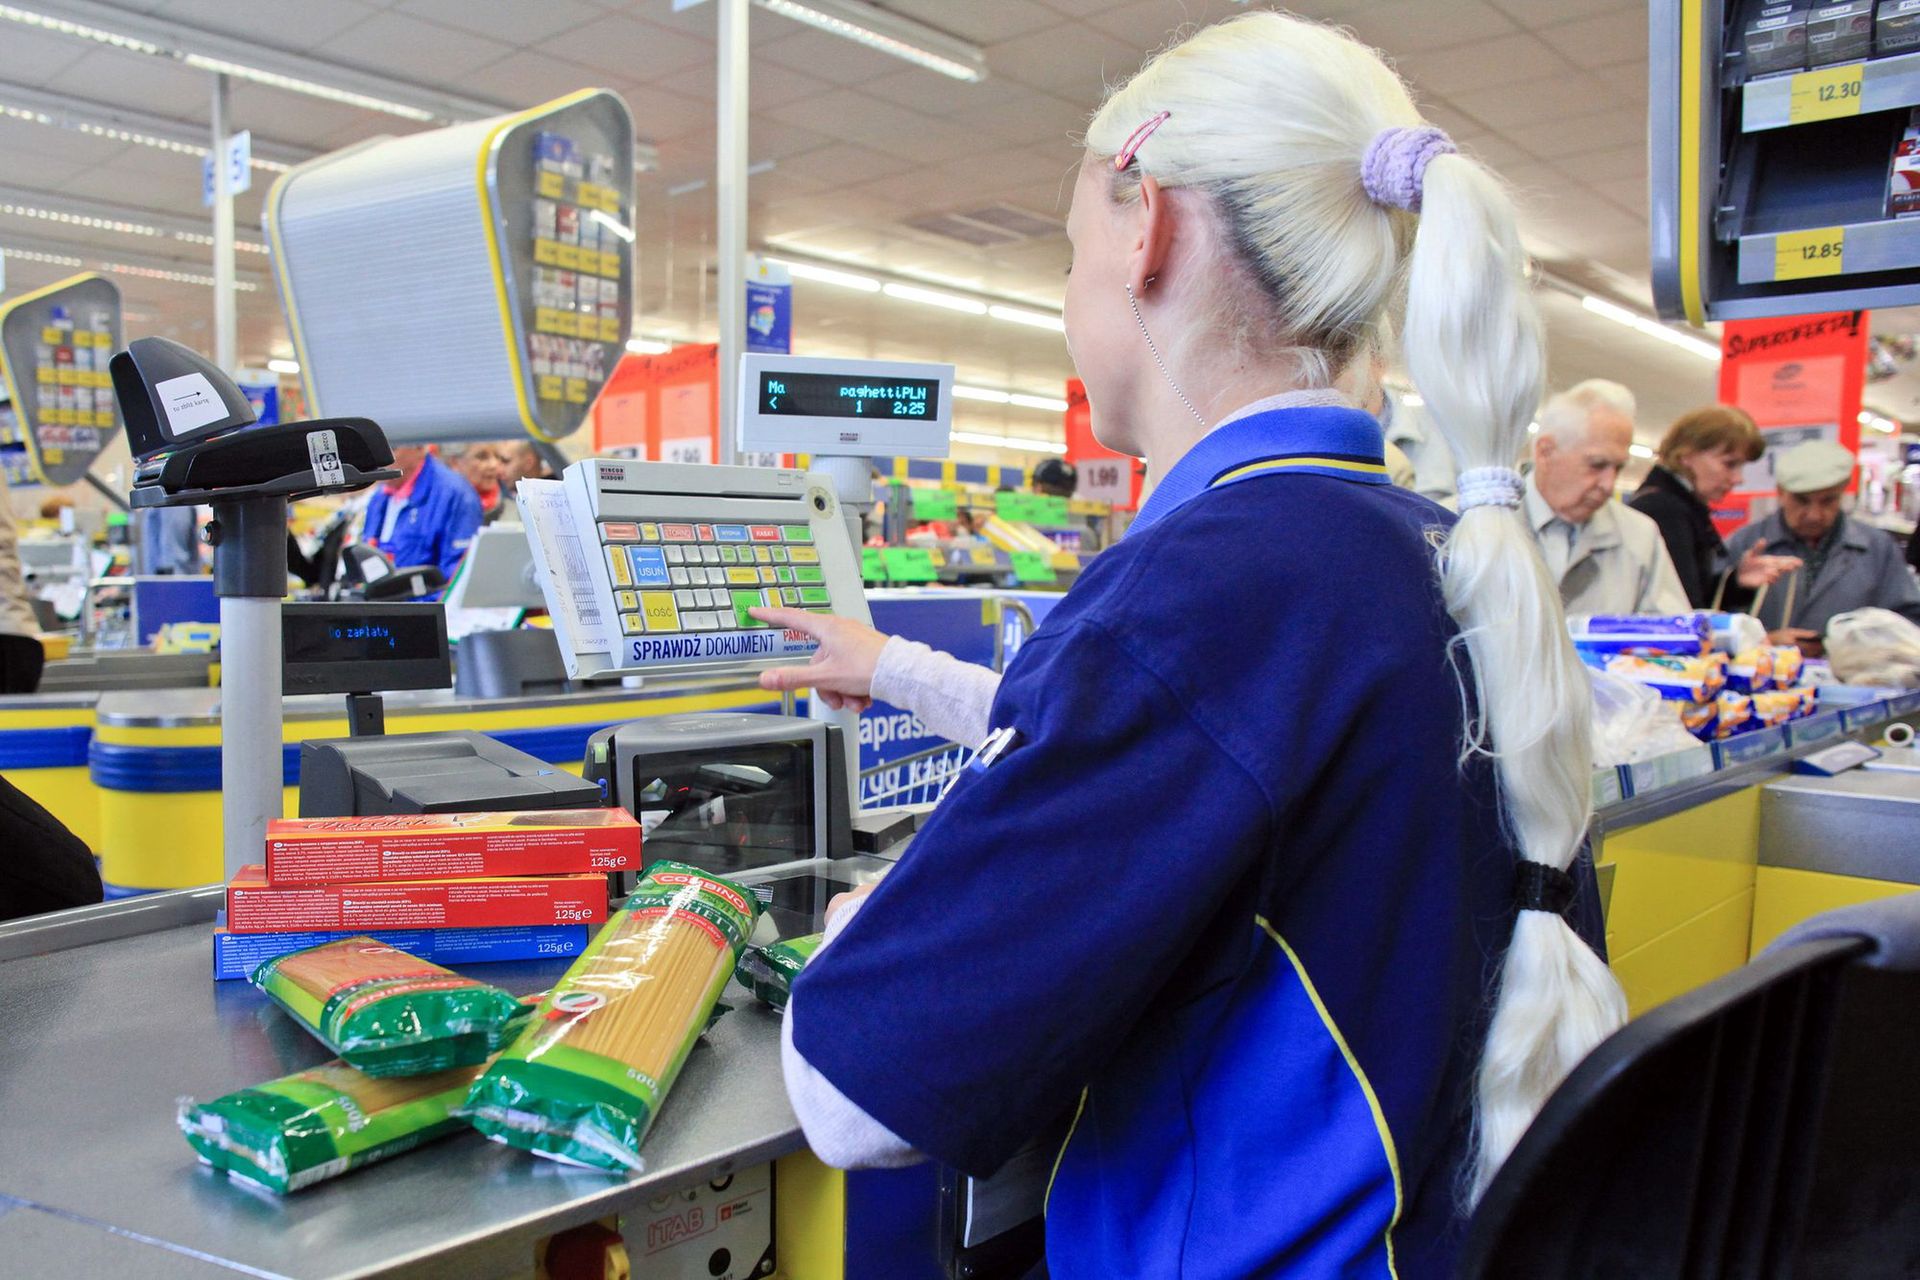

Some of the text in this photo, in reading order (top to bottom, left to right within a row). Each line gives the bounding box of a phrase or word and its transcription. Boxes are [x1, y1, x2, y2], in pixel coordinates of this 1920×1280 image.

[1818, 81, 1861, 101] 12.30
[1802, 242, 1843, 260] 12.85
[768, 380, 785, 394] Ma
[856, 401, 863, 413] 1
[893, 402, 926, 415] 2,25
[638, 565, 665, 577] USUŃ
[646, 605, 673, 617] ILOŚĆ
[633, 634, 775, 661] SPRAWDŹ DOKUMENT
[860, 713, 937, 751] apras
[632, 897, 739, 943] SPAHETTI
[647, 1207, 704, 1248] ITAB
